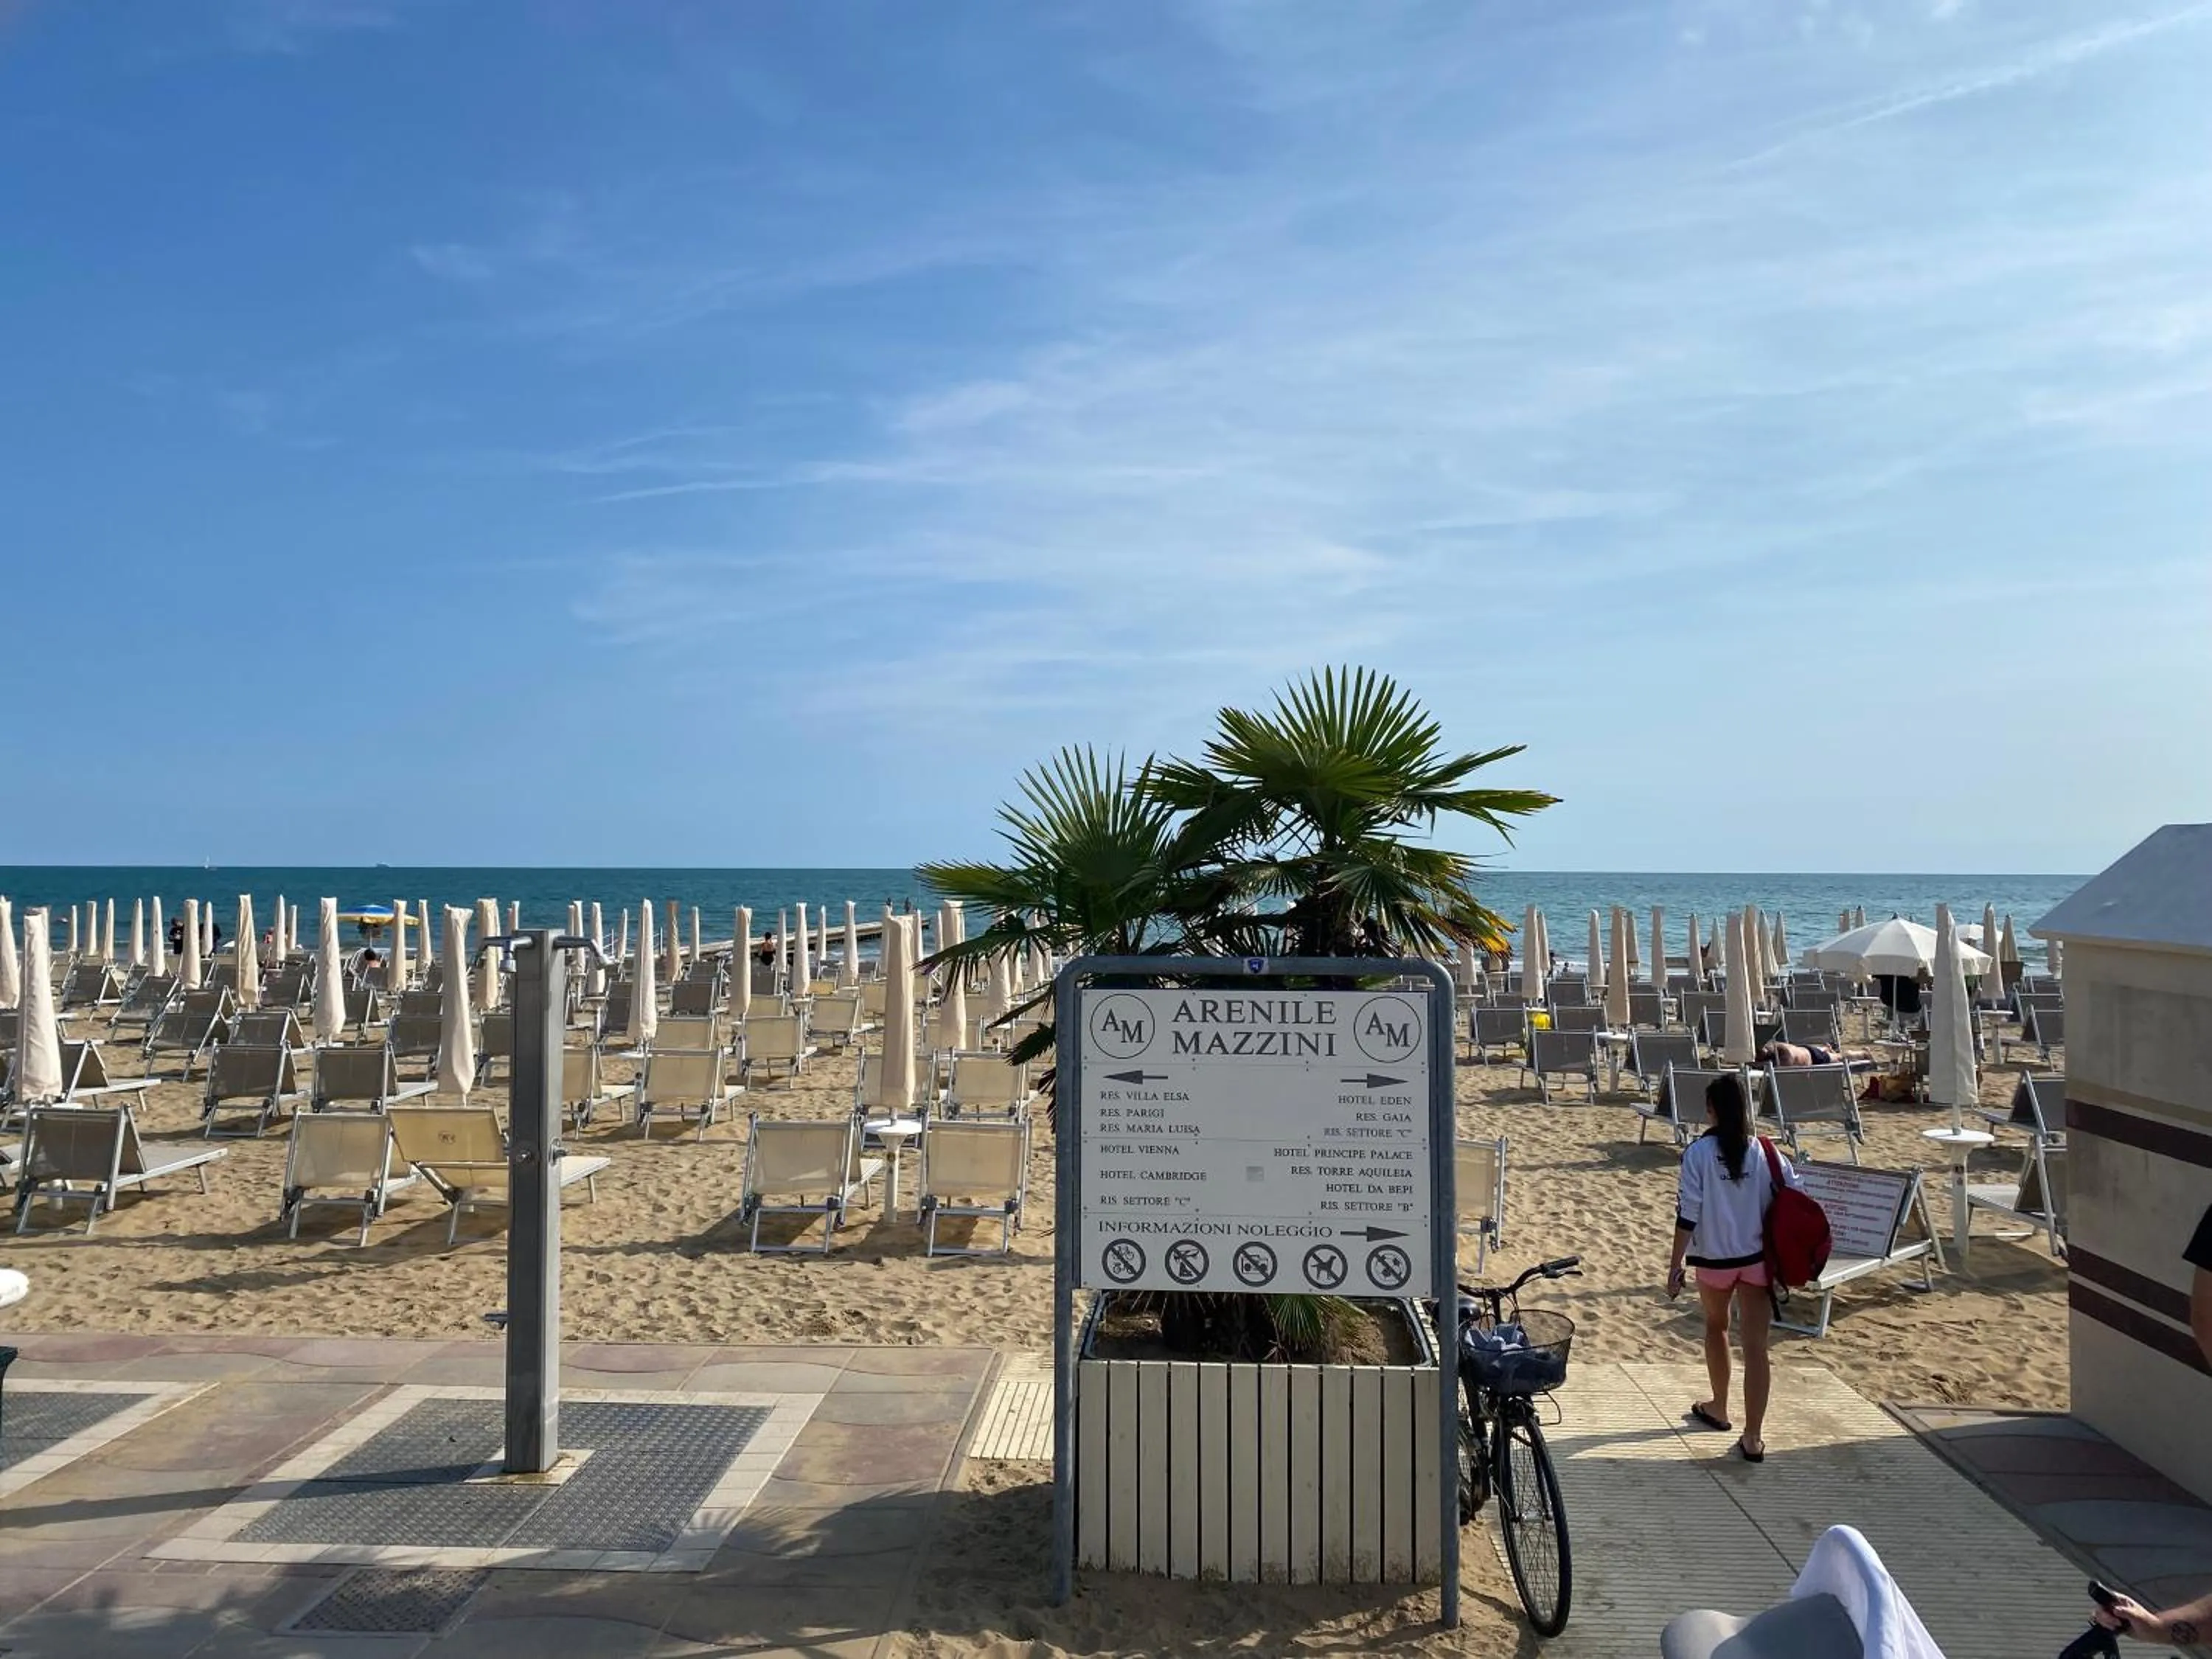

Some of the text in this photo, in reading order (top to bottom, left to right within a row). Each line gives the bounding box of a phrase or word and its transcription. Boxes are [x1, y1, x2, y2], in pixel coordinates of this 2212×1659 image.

[1172, 999, 1337, 1024] ARENILE
[1172, 1031, 1338, 1057] MAZZINI
[1127, 1092, 1159, 1101] VILLA
[1164, 1092, 1190, 1101] ELSA
[1338, 1095, 1411, 1105] HOTEL EDEN
[1127, 1109, 1165, 1118] PARIGI
[1382, 1113, 1411, 1122] GAIA
[1127, 1124, 1164, 1133] MARIA
[1169, 1124, 1200, 1133] LUISA
[1346, 1128, 1392, 1138] SETTORE
[1100, 1144, 1180, 1155] HOTEL VIENNA
[1274, 1148, 1413, 1160] HOTEL PRINCIPE PALACE
[1100, 1170, 1207, 1180] HOTEL CAMBRIDGE
[1318, 1166, 1353, 1176] TORRE
[1359, 1167, 1413, 1178] AQUILEIA
[1326, 1183, 1413, 1194] HOTEL DA BEPI
[1123, 1196, 1170, 1206] SETTORE
[1345, 1202, 1392, 1211] SETTORE
[1099, 1220, 1333, 1237] INFORMAZIONI NOLEGGIO
